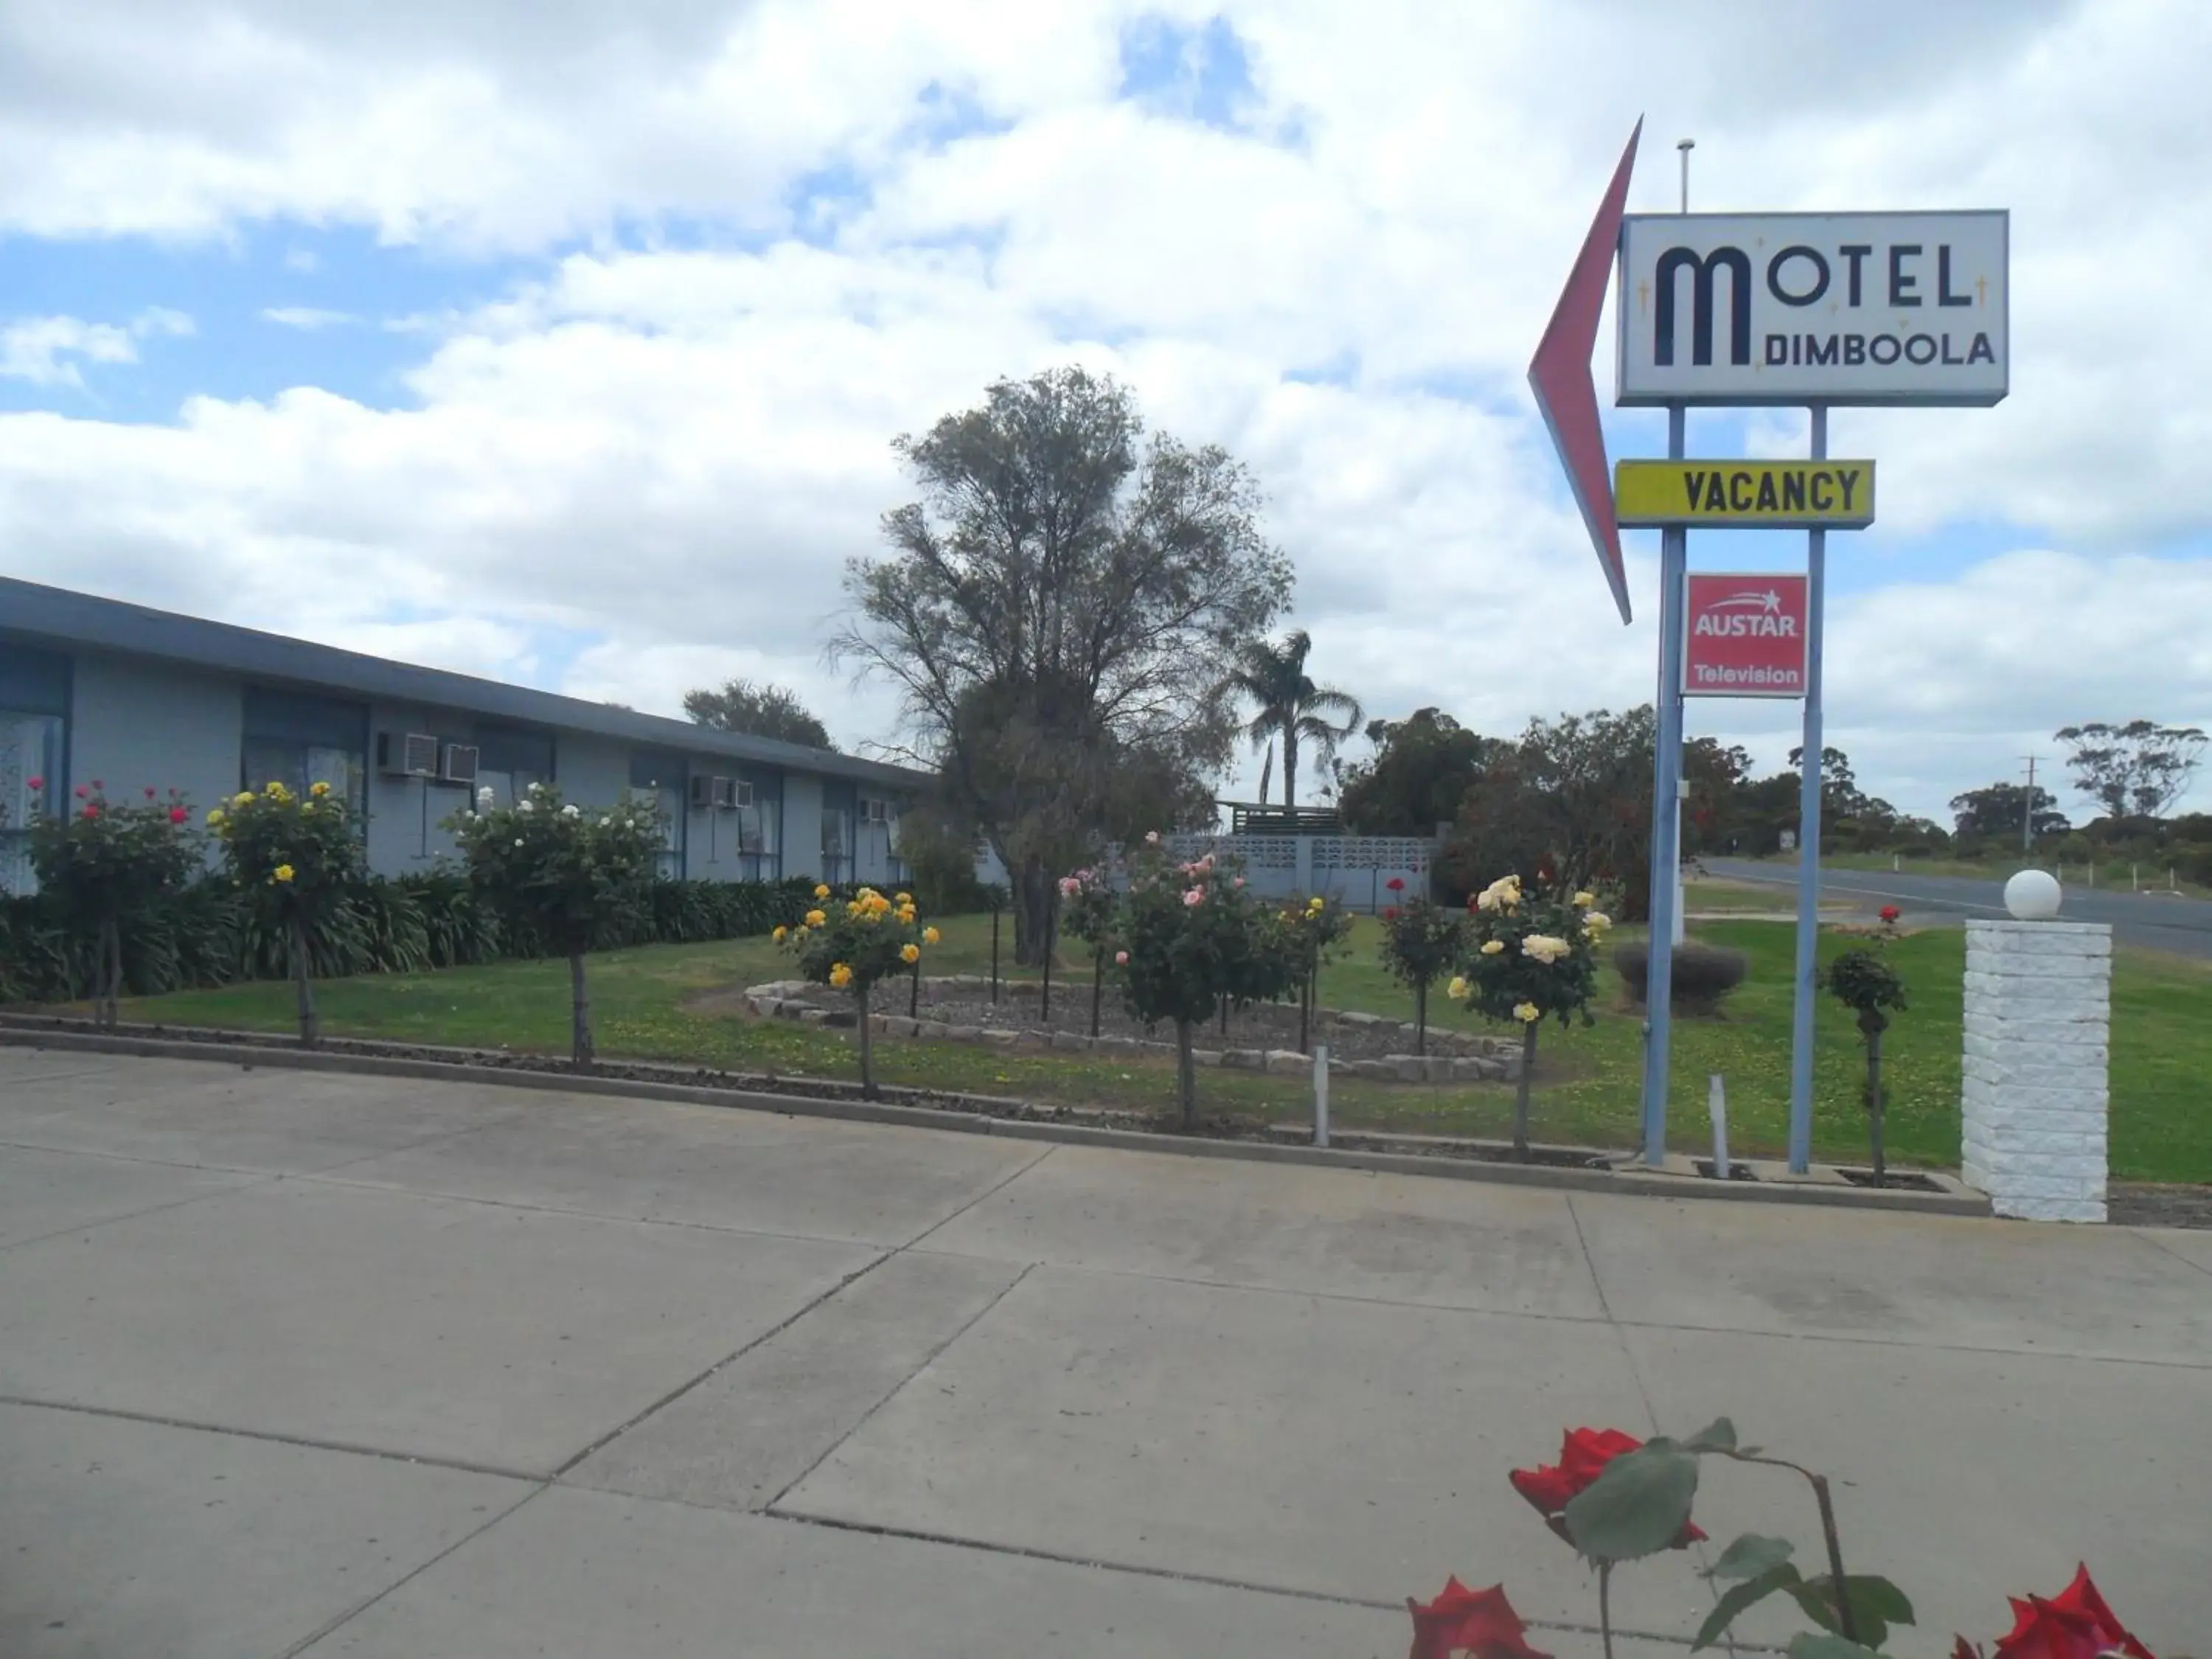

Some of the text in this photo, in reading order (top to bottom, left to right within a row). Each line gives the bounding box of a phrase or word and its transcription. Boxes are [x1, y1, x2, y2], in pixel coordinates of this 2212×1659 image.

[1654, 244, 1973, 366] MOTEL
[1765, 332, 1996, 365] DIMBOOLA
[1683, 470, 1860, 512] VACANCY
[1694, 615, 1797, 636] AUSTAR
[1694, 664, 1798, 684] Television
